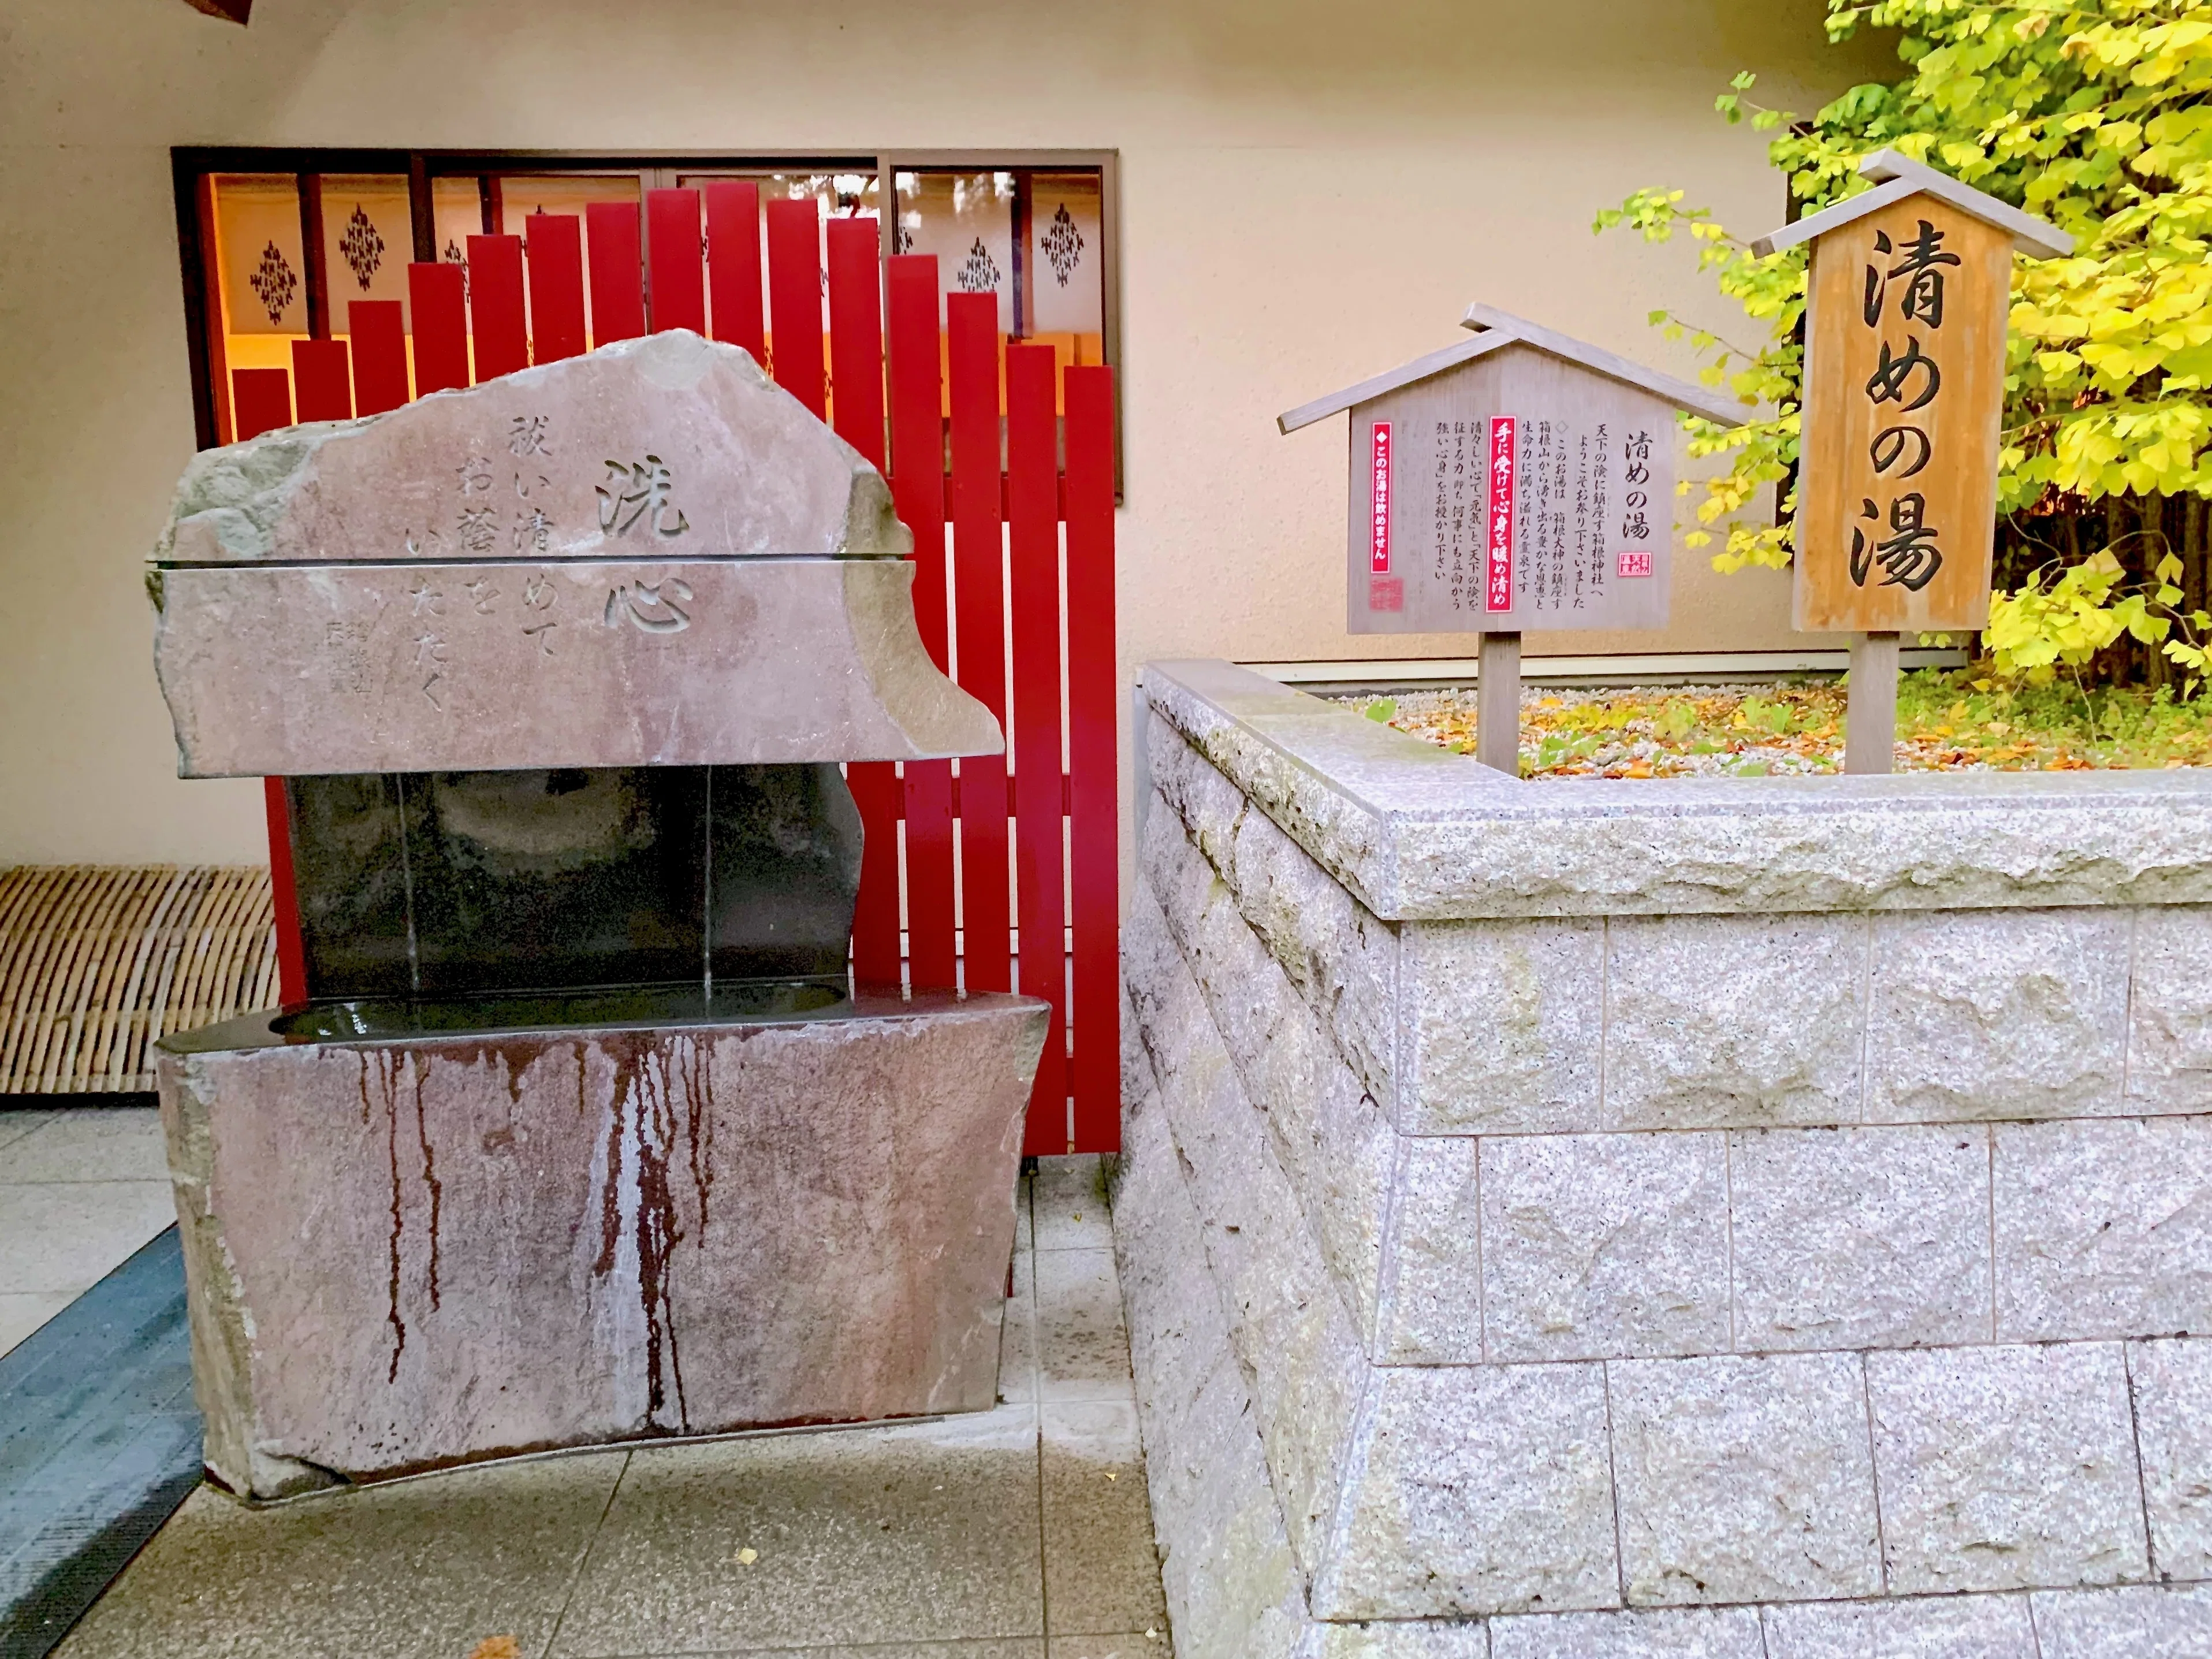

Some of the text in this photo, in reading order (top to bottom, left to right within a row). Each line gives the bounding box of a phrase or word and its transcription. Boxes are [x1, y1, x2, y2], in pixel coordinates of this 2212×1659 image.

[1622, 430, 1653, 540] 清めの湯
[1850, 220, 1961, 593] 清めの湯
[508, 415, 558, 657] 祓い清めて
[595, 455, 693, 634] 洗心
[1491, 421, 1512, 605] 手に受けて心身を暖め清め
[1573, 434, 1589, 609] ようこそお参り下さいました
